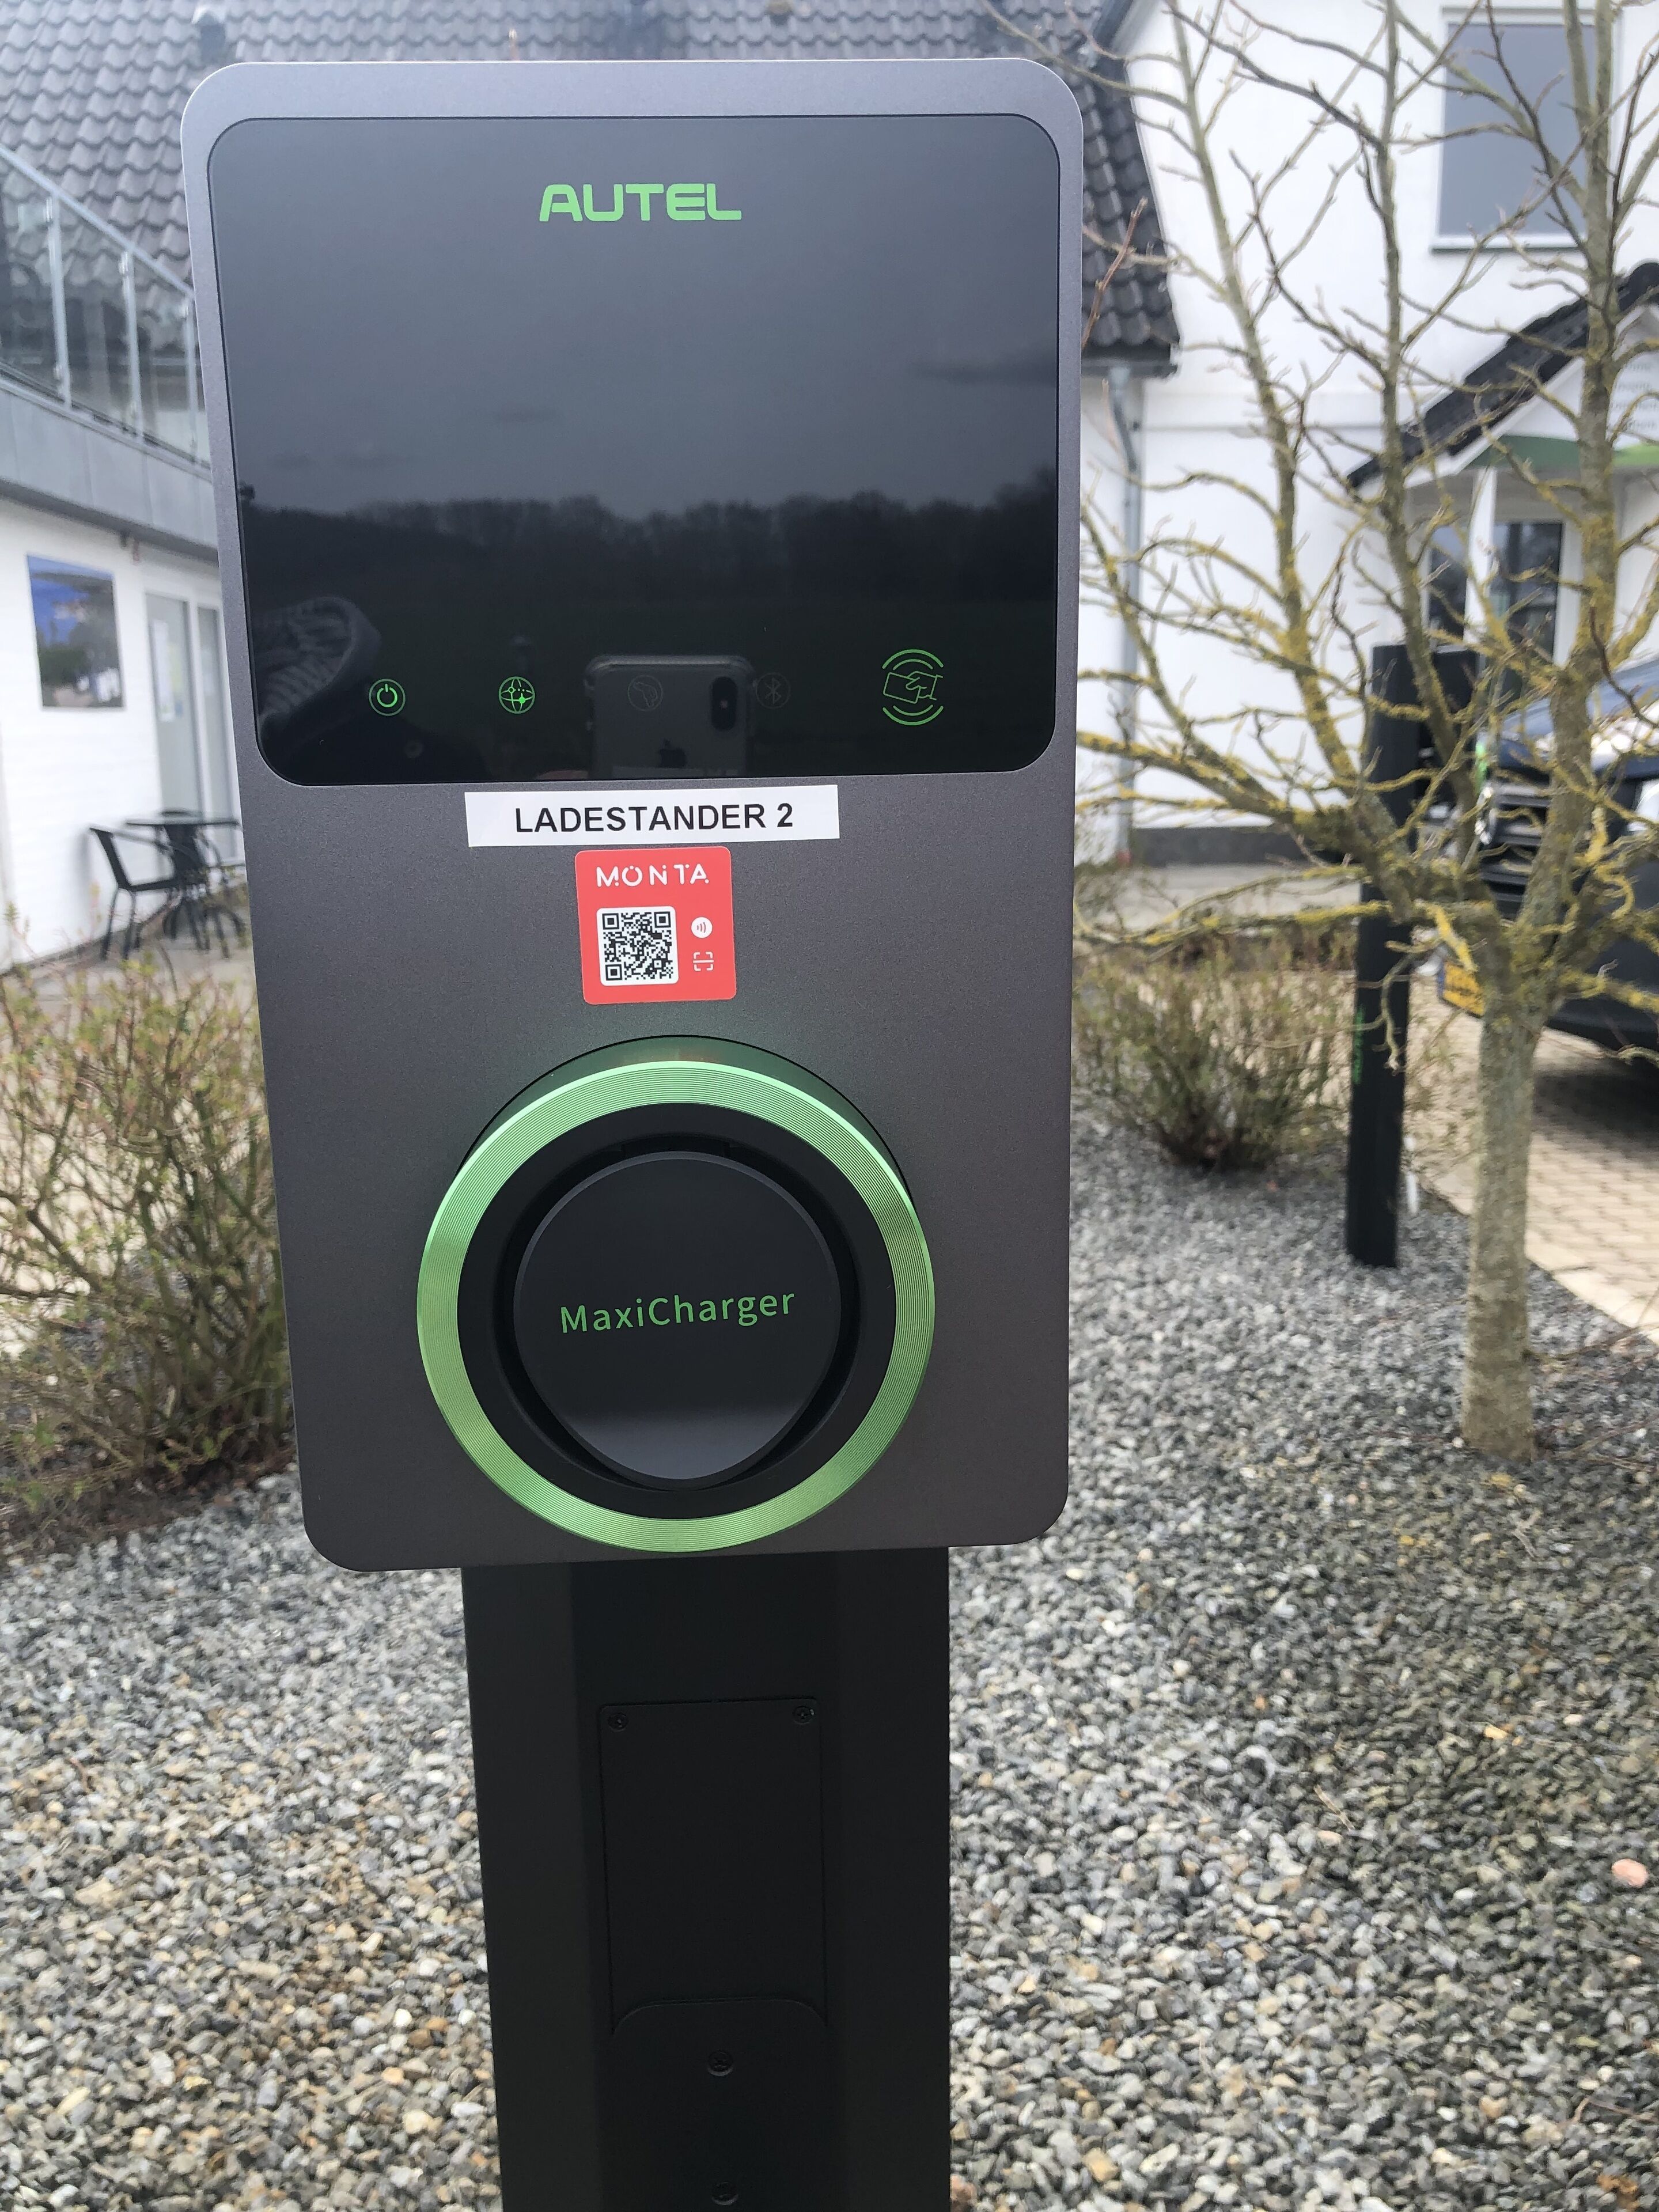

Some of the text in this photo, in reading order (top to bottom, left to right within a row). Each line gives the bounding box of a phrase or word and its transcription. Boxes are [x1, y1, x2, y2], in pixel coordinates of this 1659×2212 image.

[539, 183, 741, 222] AUTEL
[515, 803, 793, 832] LADESTANDER 2
[596, 863, 710, 887] MONTA
[560, 1293, 794, 1333] MaxiCharger
